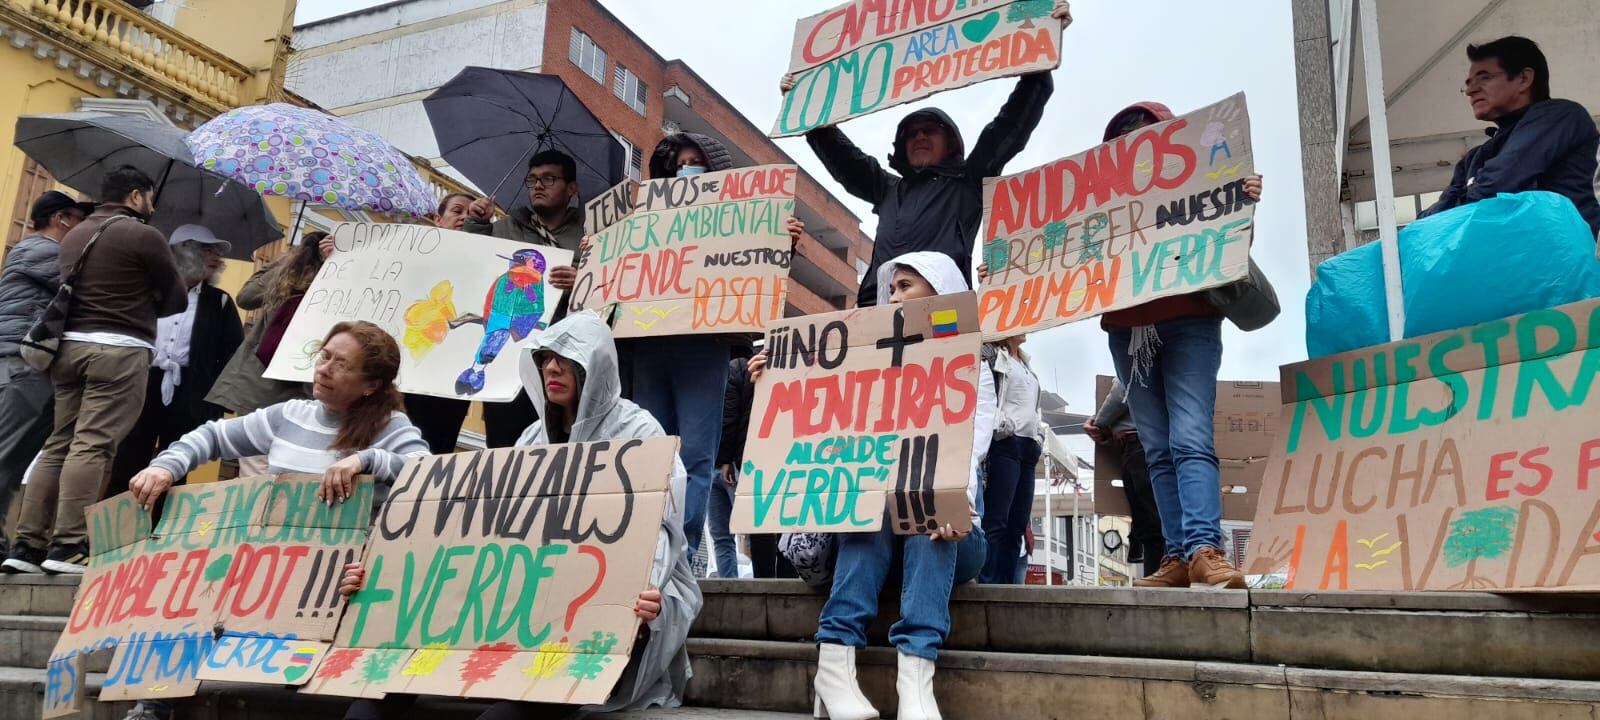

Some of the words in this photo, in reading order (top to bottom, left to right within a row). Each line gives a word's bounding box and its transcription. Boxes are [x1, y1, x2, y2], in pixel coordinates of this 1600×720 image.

[890, 28, 1058, 99] PROTEGIDA
[903, 24, 959, 64] AREA
[780, 42, 894, 133] COMO
[589, 176, 700, 234] TENEMOS
[701, 180, 719, 193] DE
[719, 168, 797, 200] ALCALDE
[1156, 178, 1258, 229] NUESTR
[334, 223, 441, 254] CAMINO
[320, 259, 354, 280] DE
[369, 260, 403, 280] LA
[601, 245, 699, 301] VENDE
[704, 248, 791, 269] NUESTROS
[979, 258, 1121, 332] PULMÓN
[1131, 217, 1251, 297] VERDE
[304, 287, 402, 322] PALMA
[758, 354, 977, 438] MENTIRAS
[785, 434, 900, 465] ALCALDE
[1273, 438, 1467, 515] LUCHA
[1485, 446, 1553, 501] ES
[162, 548, 211, 619] EL
[212, 543, 310, 620] POT
